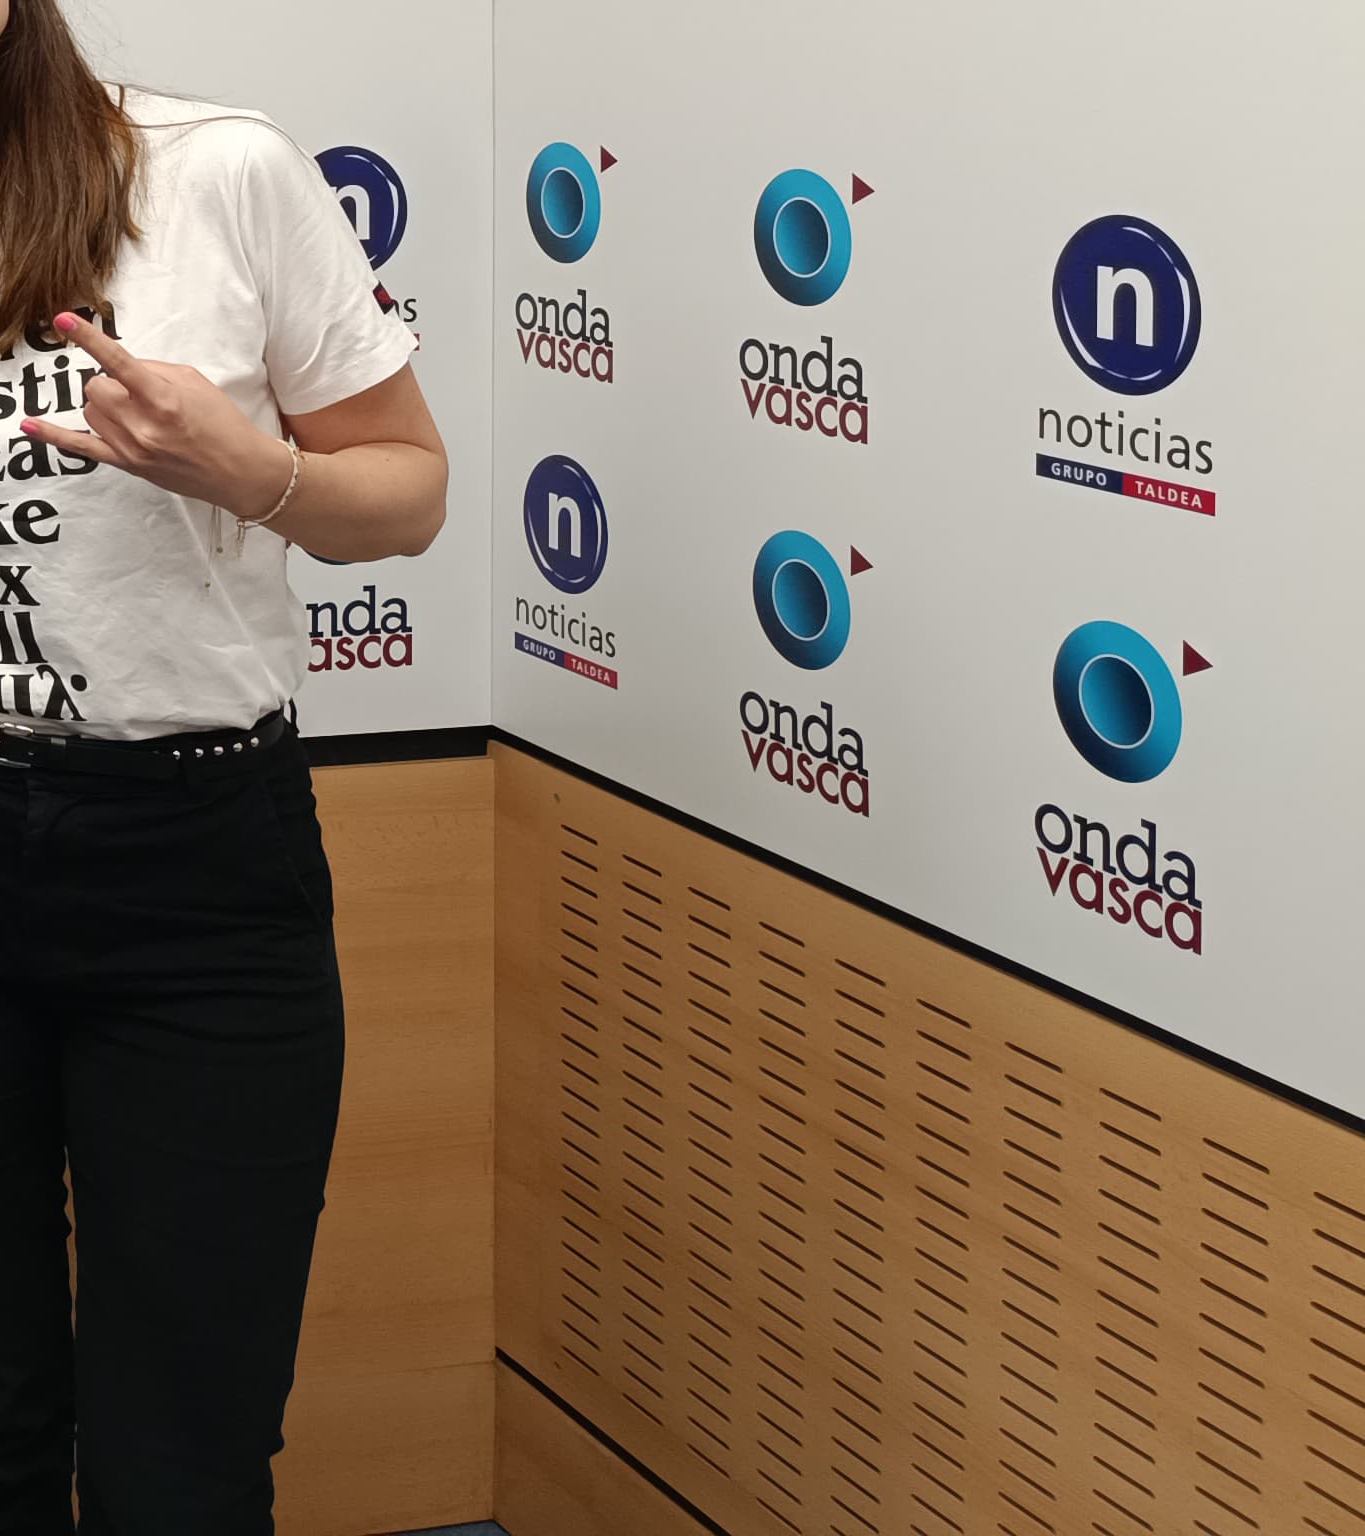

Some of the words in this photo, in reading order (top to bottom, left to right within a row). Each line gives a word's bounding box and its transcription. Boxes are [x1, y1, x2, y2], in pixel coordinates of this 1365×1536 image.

[515, 289, 613, 347] onda
[1096, 264, 1154, 347] n
[516, 328, 614, 383] vasca
[740, 336, 868, 404] onda
[741, 378, 869, 444] vasca
[1038, 407, 1213, 475] noticias
[1051, 462, 1107, 486] GRUPO
[1135, 480, 1203, 509] TALDEA
[548, 492, 581, 558] n
[306, 585, 412, 638] nda
[516, 597, 616, 658] noticias
[307, 634, 413, 672] asca
[522, 639, 556, 661] GRUPO
[571, 658, 611, 683] TALDEA
[740, 691, 868, 777] onda
[741, 729, 869, 817] vasca
[1035, 804, 1202, 909] onda
[1037, 847, 1202, 956] vasca
